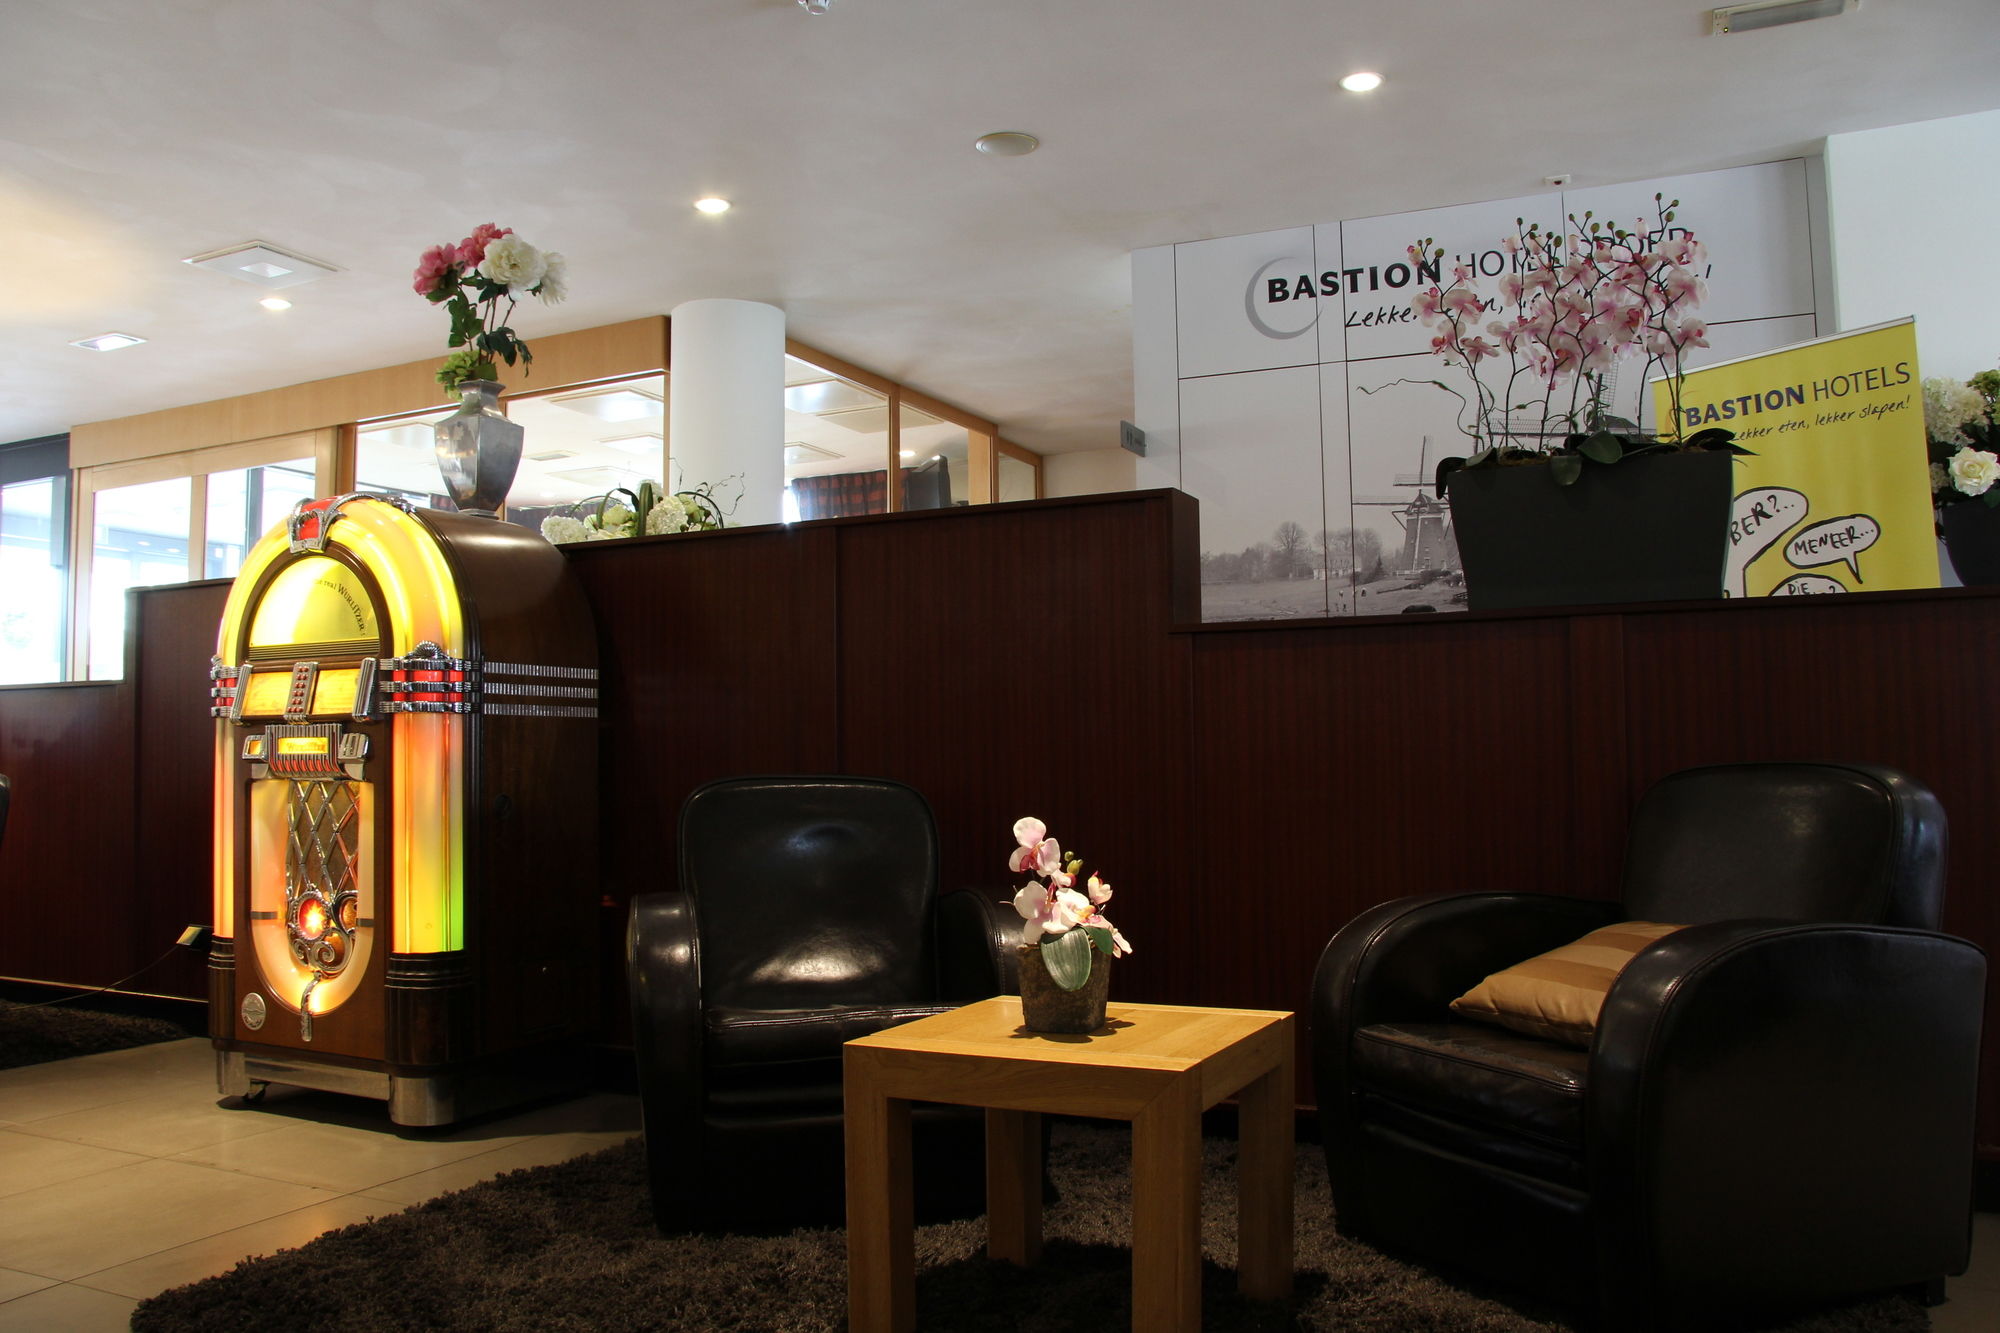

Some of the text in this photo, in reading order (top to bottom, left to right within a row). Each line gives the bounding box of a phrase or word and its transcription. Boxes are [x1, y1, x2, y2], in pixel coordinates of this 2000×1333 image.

[1267, 257, 1441, 303] BASTION
[1345, 304, 1418, 328] Lekke
[1685, 361, 1911, 428] BASTION HOTELS
[1778, 417, 1811, 434] eten,
[1814, 410, 1856, 427] lekker
[1858, 395, 1911, 421] slapen!
